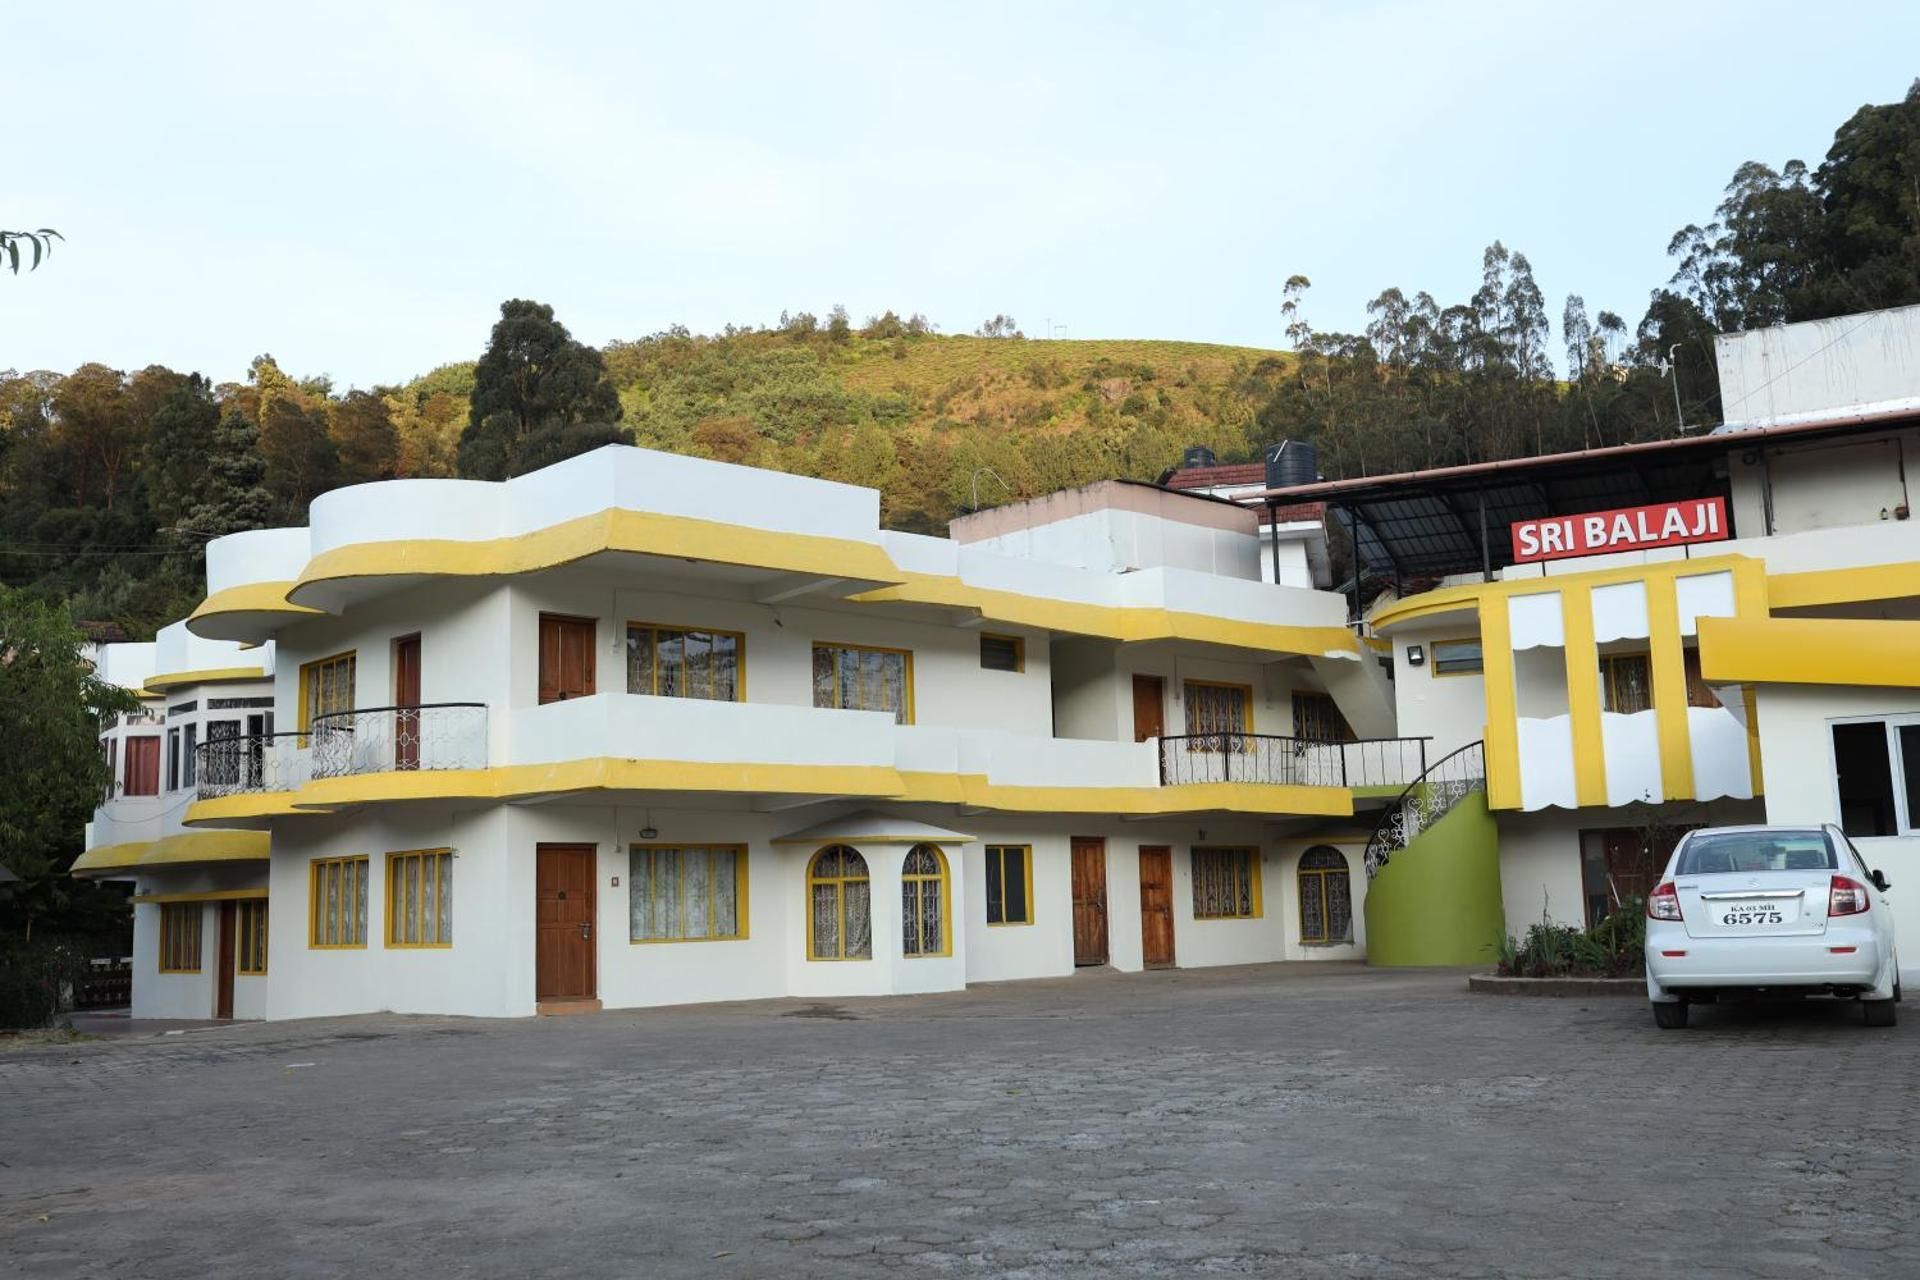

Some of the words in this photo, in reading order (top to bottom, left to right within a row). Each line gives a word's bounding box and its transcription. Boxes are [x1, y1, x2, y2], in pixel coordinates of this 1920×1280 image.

[1519, 520, 1575, 556] SRI
[1584, 502, 1719, 549] BALAJI
[1723, 912, 1783, 925] 6575
